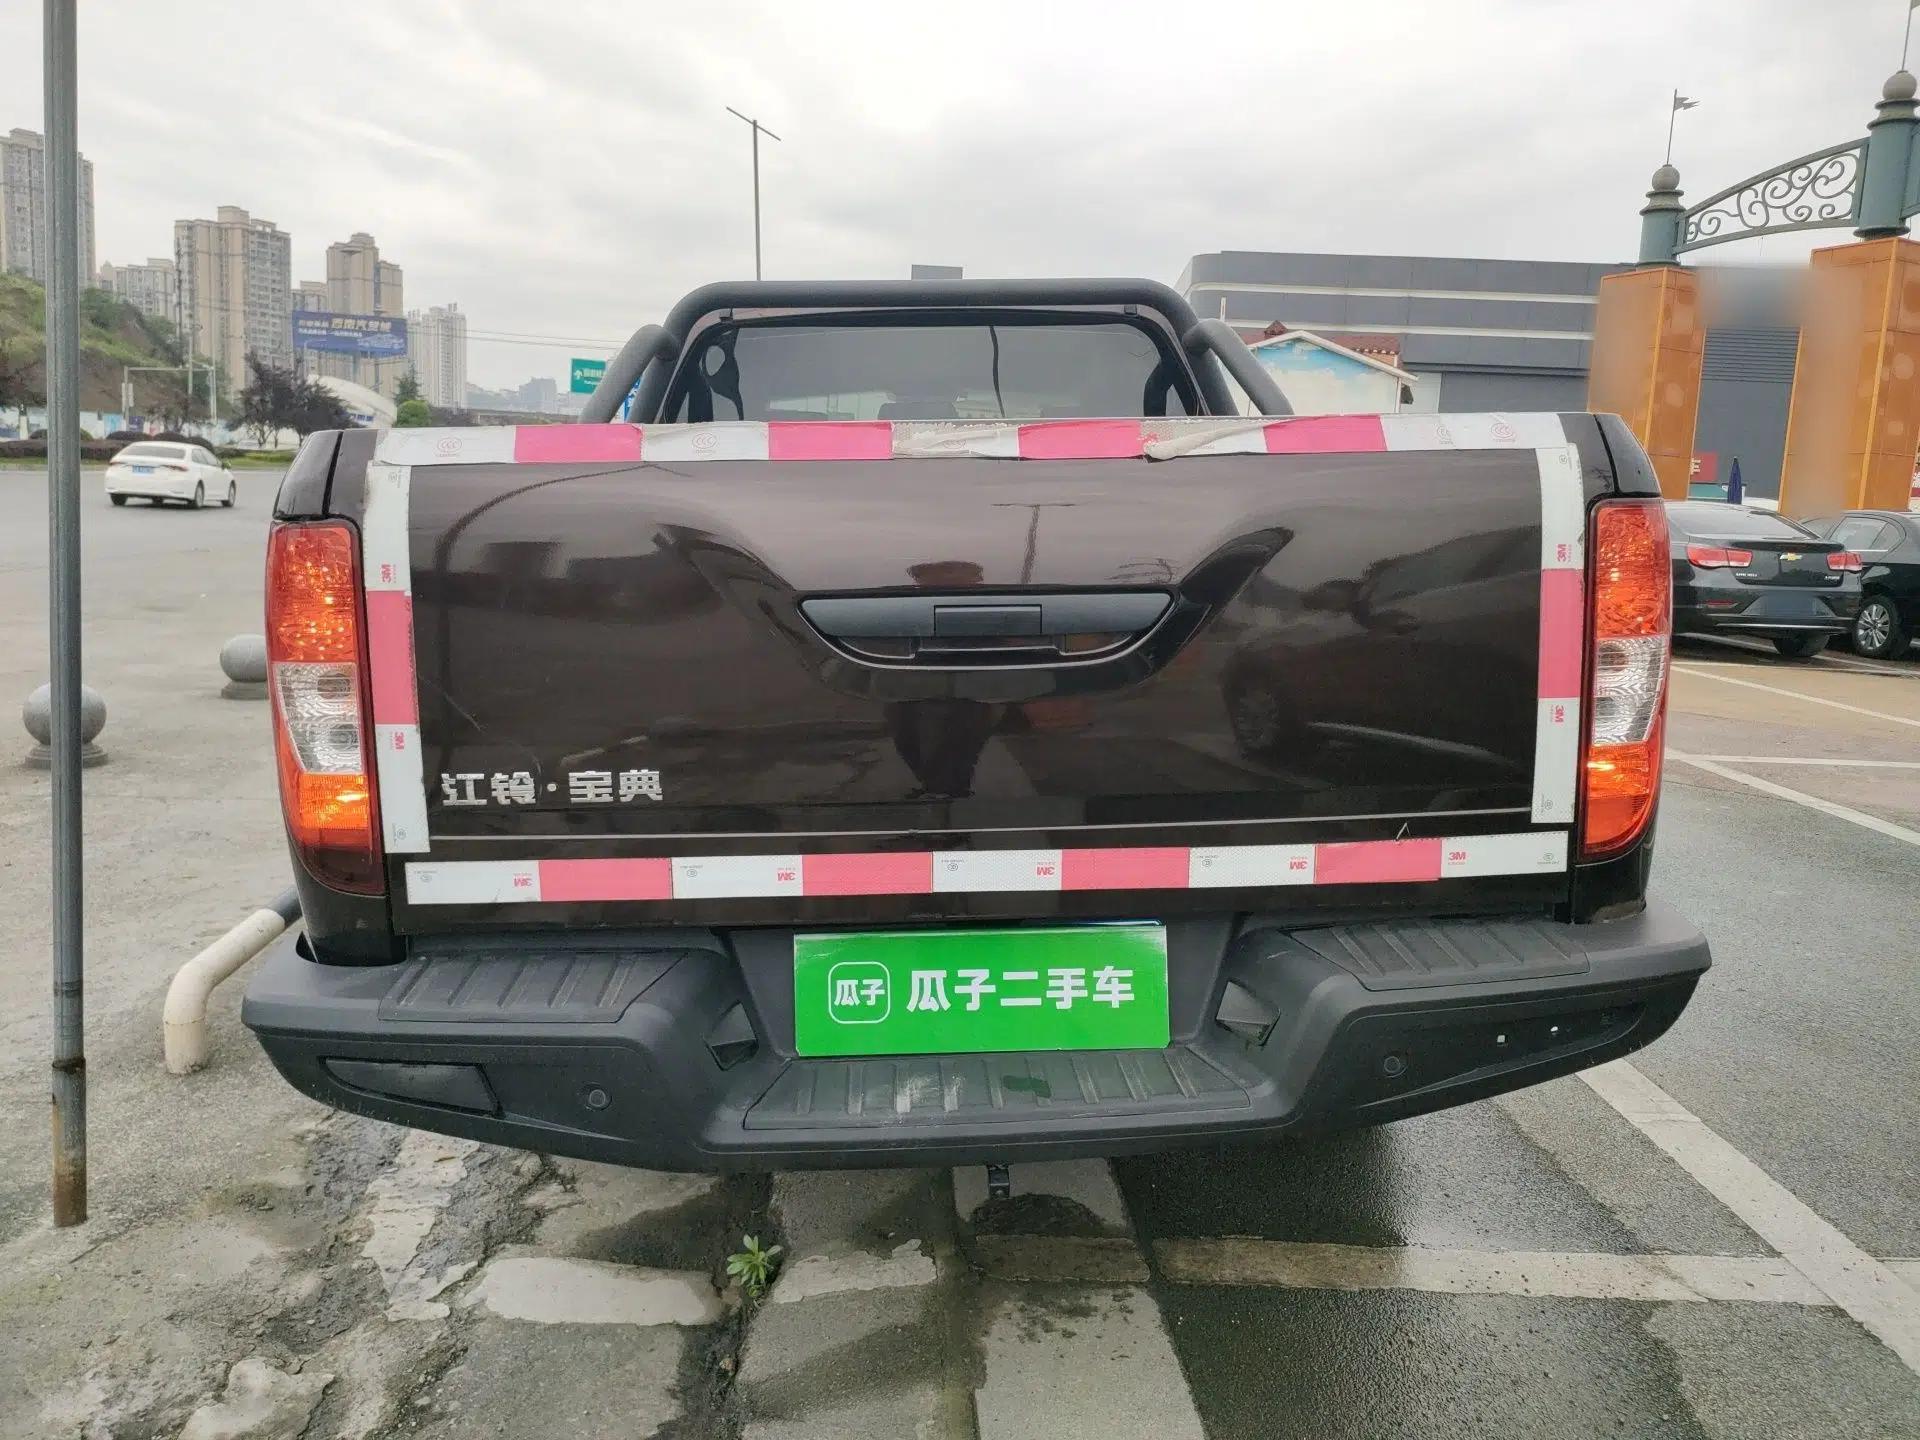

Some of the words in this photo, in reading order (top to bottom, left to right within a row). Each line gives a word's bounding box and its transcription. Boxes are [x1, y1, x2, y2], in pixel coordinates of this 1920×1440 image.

[1557, 543, 1567, 562] 3M
[382, 564, 392, 583] 3M
[1555, 705, 1564, 723] 3M
[395, 731, 405, 750] 3M
[1289, 861, 1308, 870] 3M
[1448, 852, 1466, 861] 3M
[777, 872, 796, 881] 3M
[1037, 866, 1055, 876] 3M
[513, 877, 532, 887] 3M
[834, 979, 885, 1006] 瓜子
[906, 965, 1135, 1012] 瓜子二手车
